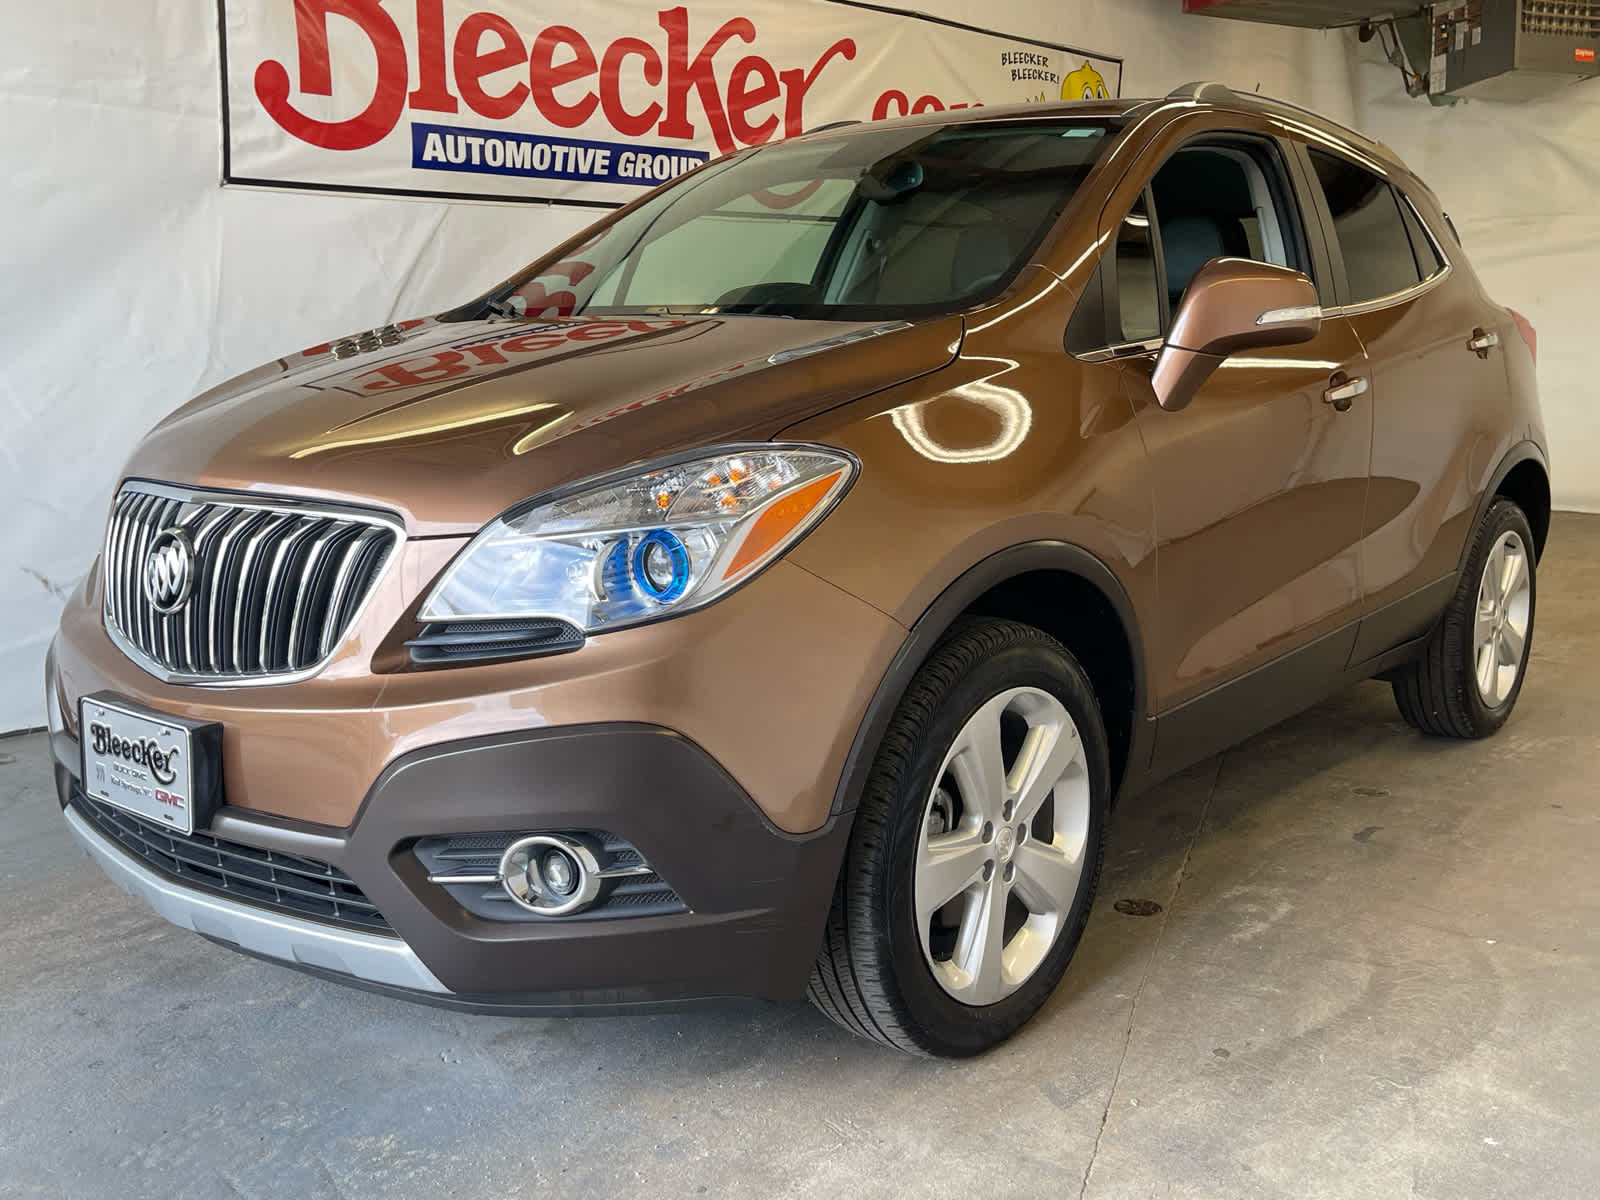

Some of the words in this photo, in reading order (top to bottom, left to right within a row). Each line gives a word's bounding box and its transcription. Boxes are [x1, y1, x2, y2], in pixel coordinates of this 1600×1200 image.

[1001, 52, 1049, 68] BLEECKER
[1011, 68, 1060, 84] BLEECKER!
[422, 133, 611, 176] AUTOMOTIVE
[90, 723, 179, 785] Bleecker
[155, 789, 185, 809] GMC
